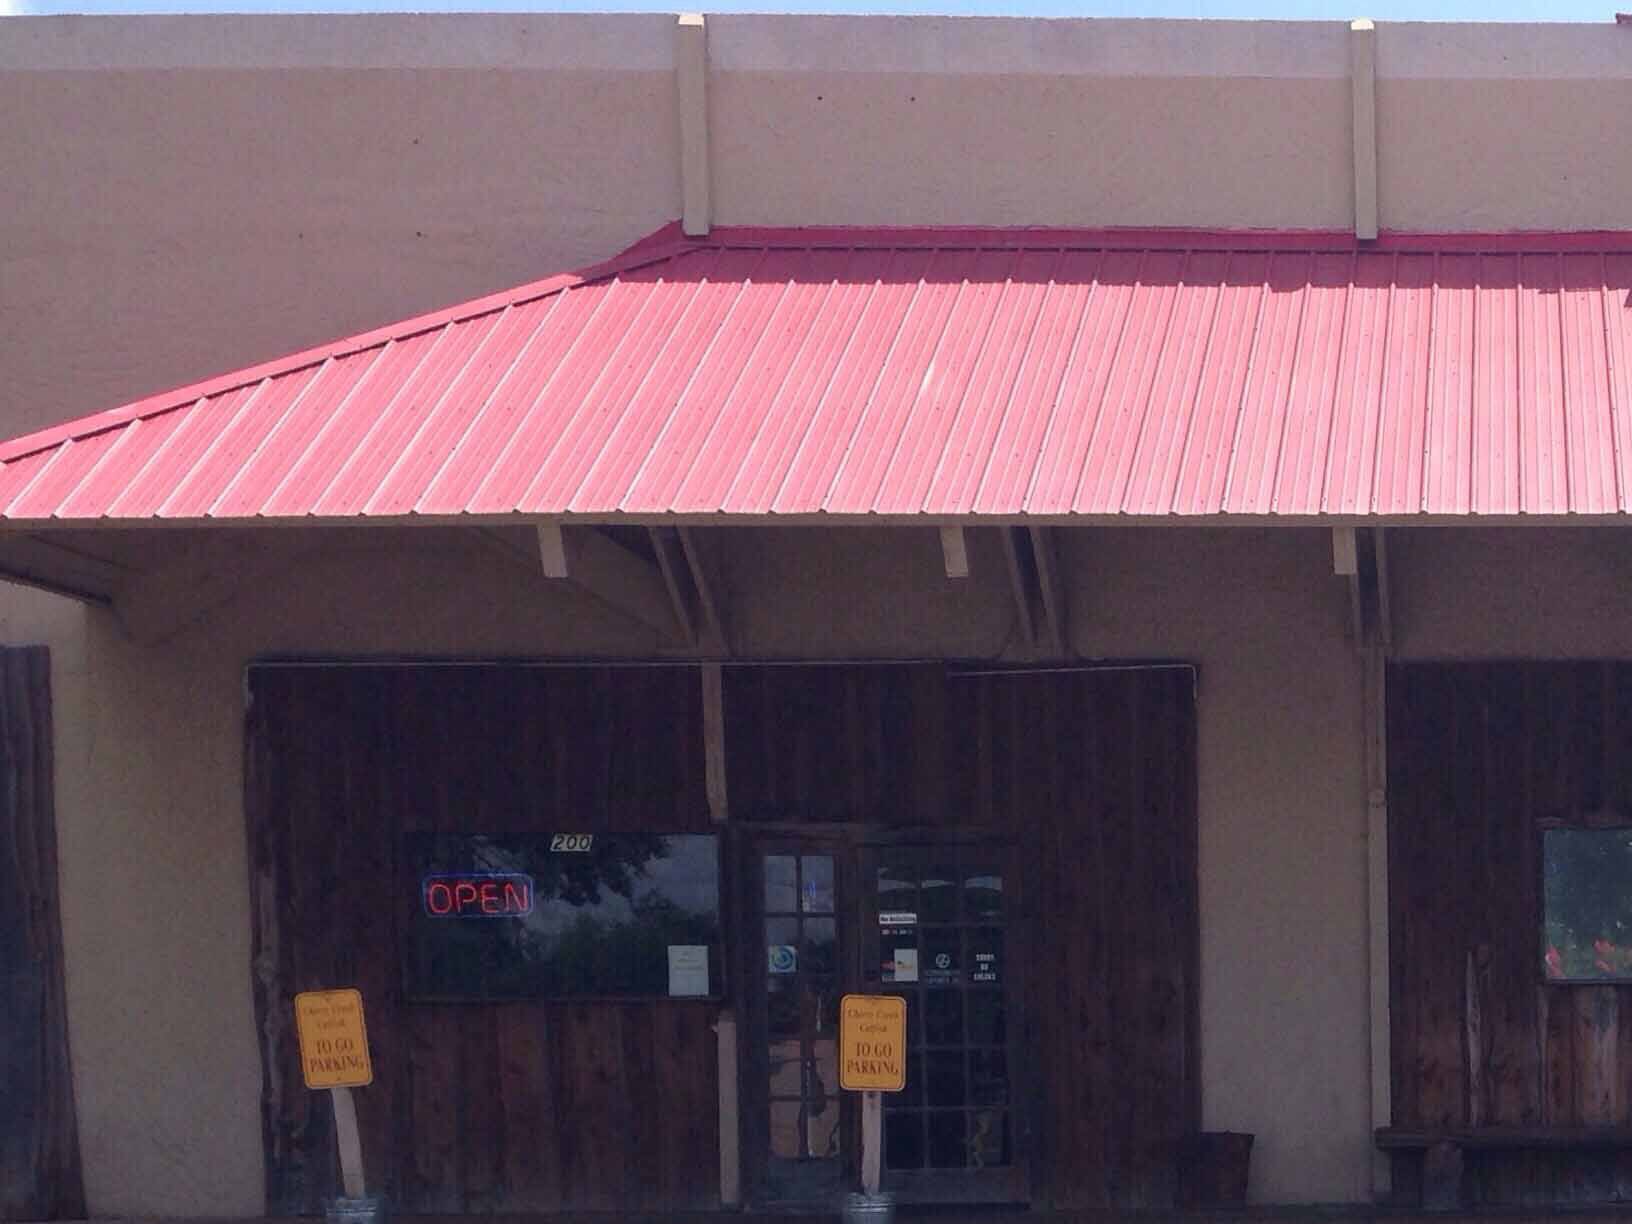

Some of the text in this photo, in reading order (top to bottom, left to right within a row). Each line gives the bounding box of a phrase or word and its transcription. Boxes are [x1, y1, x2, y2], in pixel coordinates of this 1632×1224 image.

[553, 834, 590, 850] 200
[428, 883, 528, 915] OPEN
[314, 1039, 354, 1054] TO GO
[855, 1042, 893, 1057] TO GO
[310, 1056, 366, 1073] PARKING
[846, 1060, 900, 1075] PARKING
